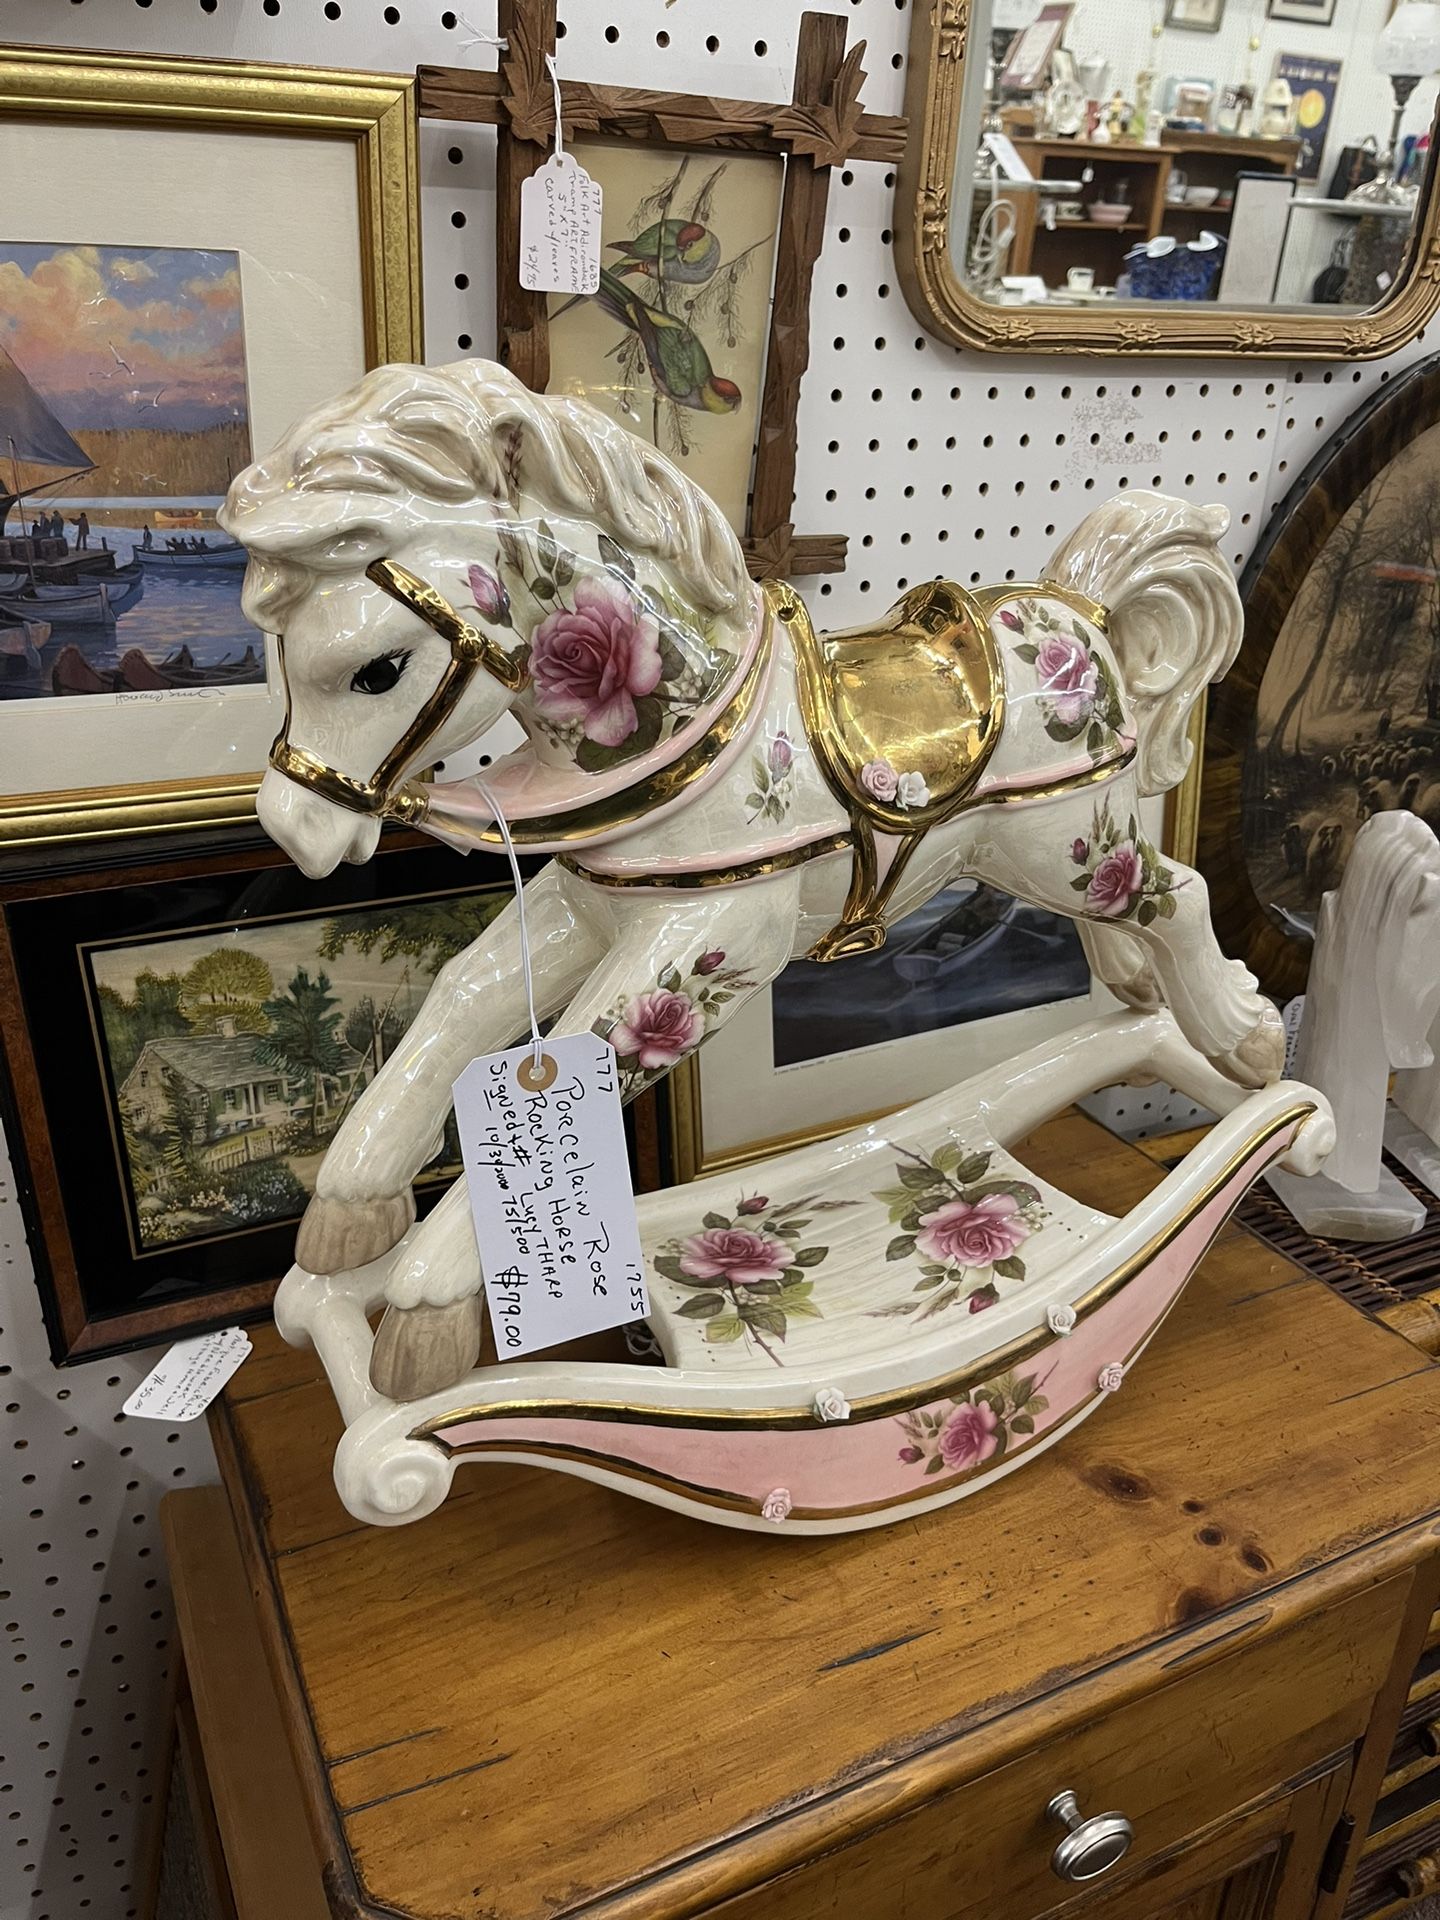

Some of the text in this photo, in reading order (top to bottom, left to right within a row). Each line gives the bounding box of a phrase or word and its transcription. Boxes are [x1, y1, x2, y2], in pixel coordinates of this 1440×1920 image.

[593, 189, 601, 215] 777
[596, 1048, 644, 1315] 777 1755
[502, 1195, 530, 1255] 75/500
[584, 1221, 610, 1296] Rose
[491, 1265, 528, 1347] $79.00
